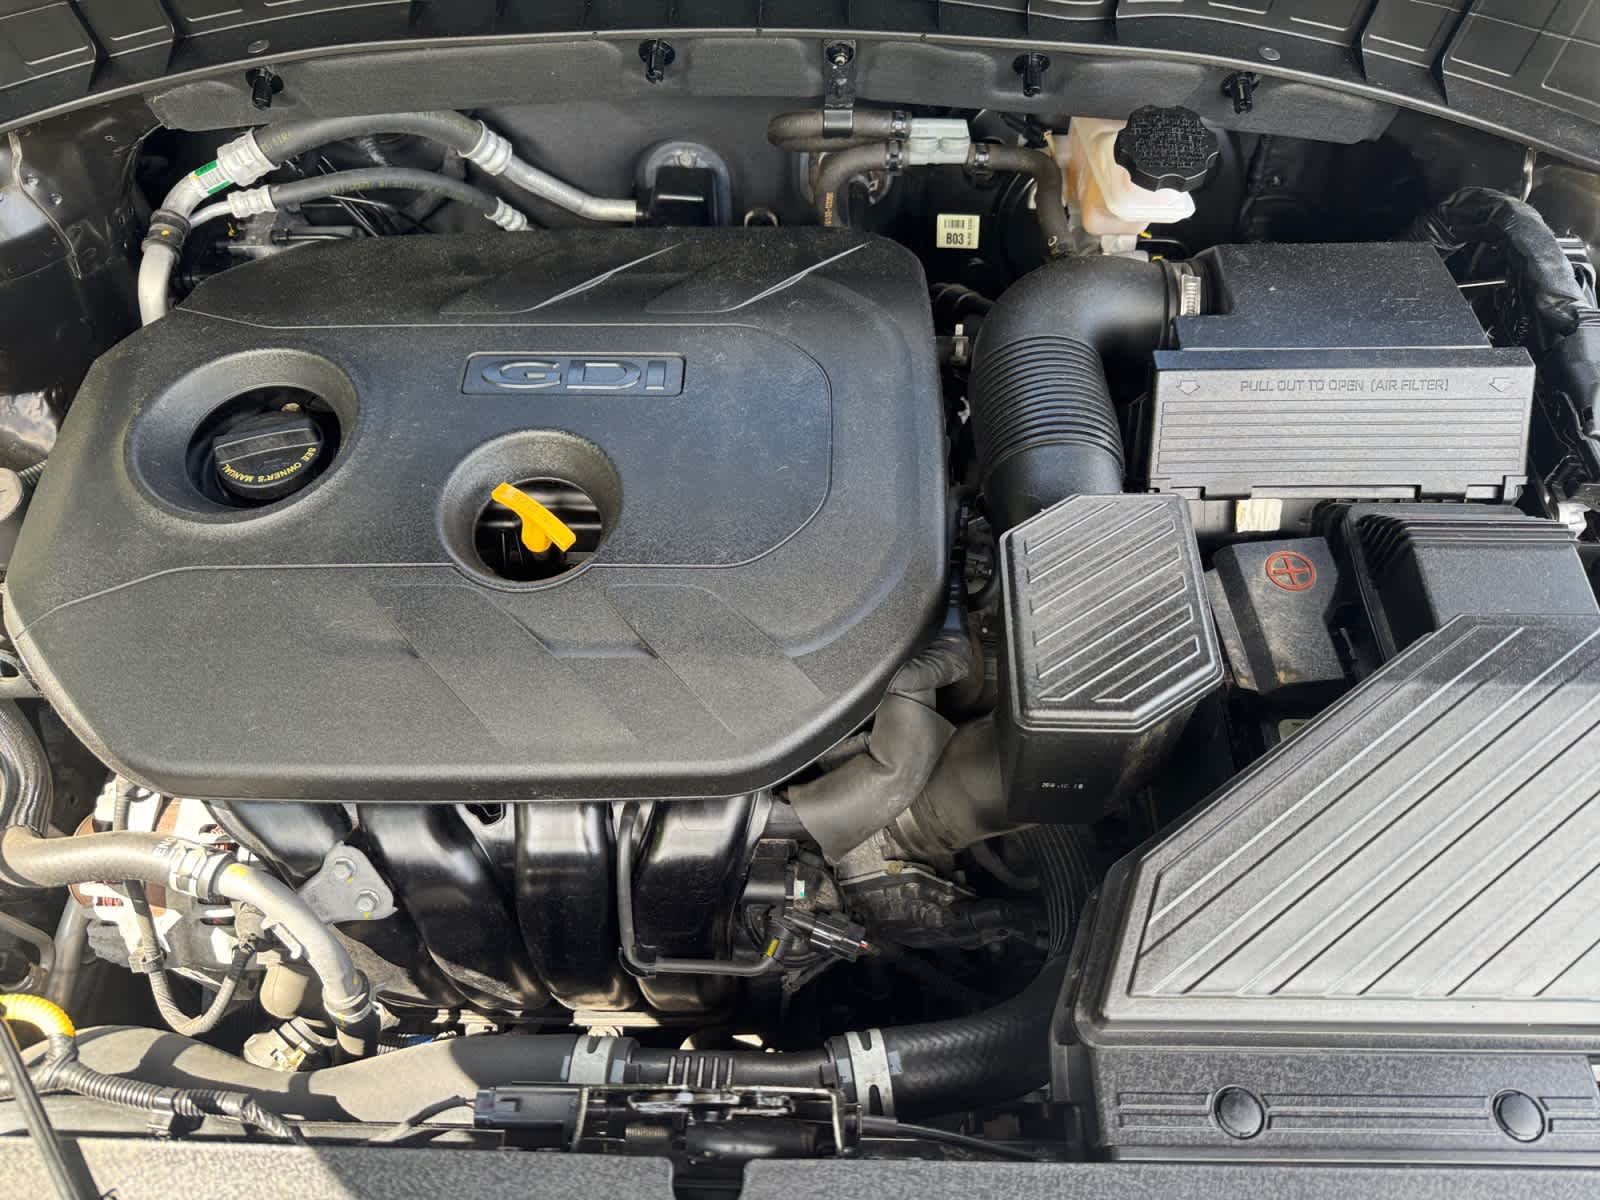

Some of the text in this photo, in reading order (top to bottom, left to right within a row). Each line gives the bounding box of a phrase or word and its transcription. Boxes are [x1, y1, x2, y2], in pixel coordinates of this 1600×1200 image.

[946, 232, 964, 245] B03
[481, 359, 667, 391] GDI
[1240, 380, 1273, 392] PULL
[1277, 380, 1304, 391] OUT
[1308, 380, 1324, 391] TO
[1328, 379, 1363, 391] OPEN
[222, 447, 317, 483] SEE OWNER'S MANUAL
